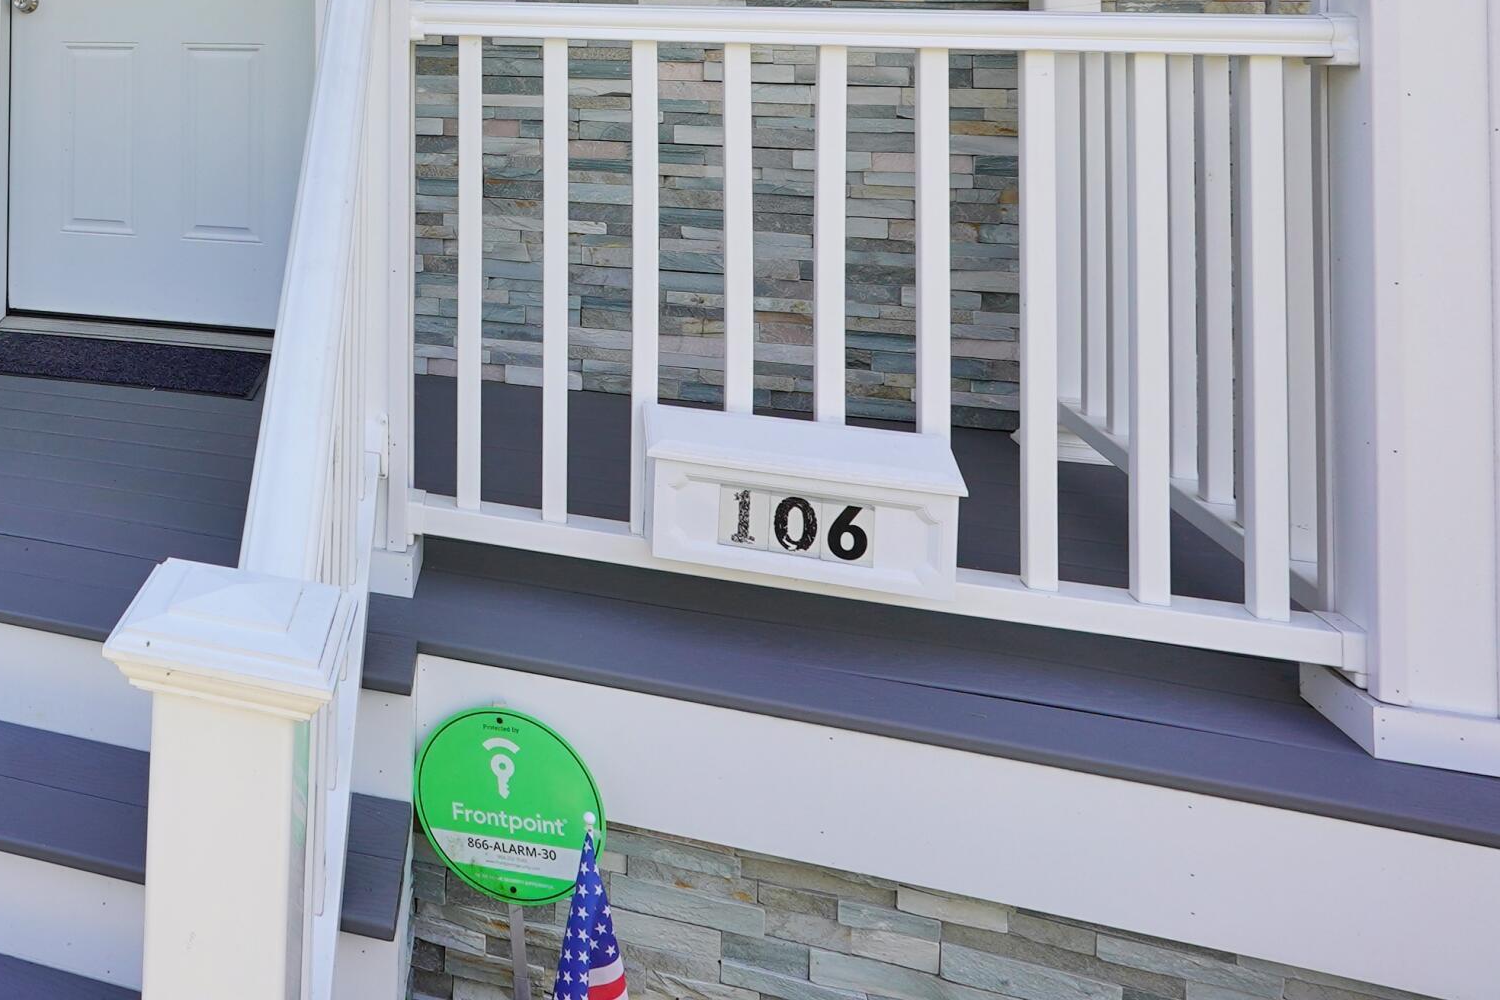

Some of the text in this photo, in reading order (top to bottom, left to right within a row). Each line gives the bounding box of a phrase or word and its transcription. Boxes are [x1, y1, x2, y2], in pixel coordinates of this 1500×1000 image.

[731, 489, 868, 561] 106
[451, 801, 565, 837] Frontpoint
[467, 837, 557, 861] 866-ALARM-30
